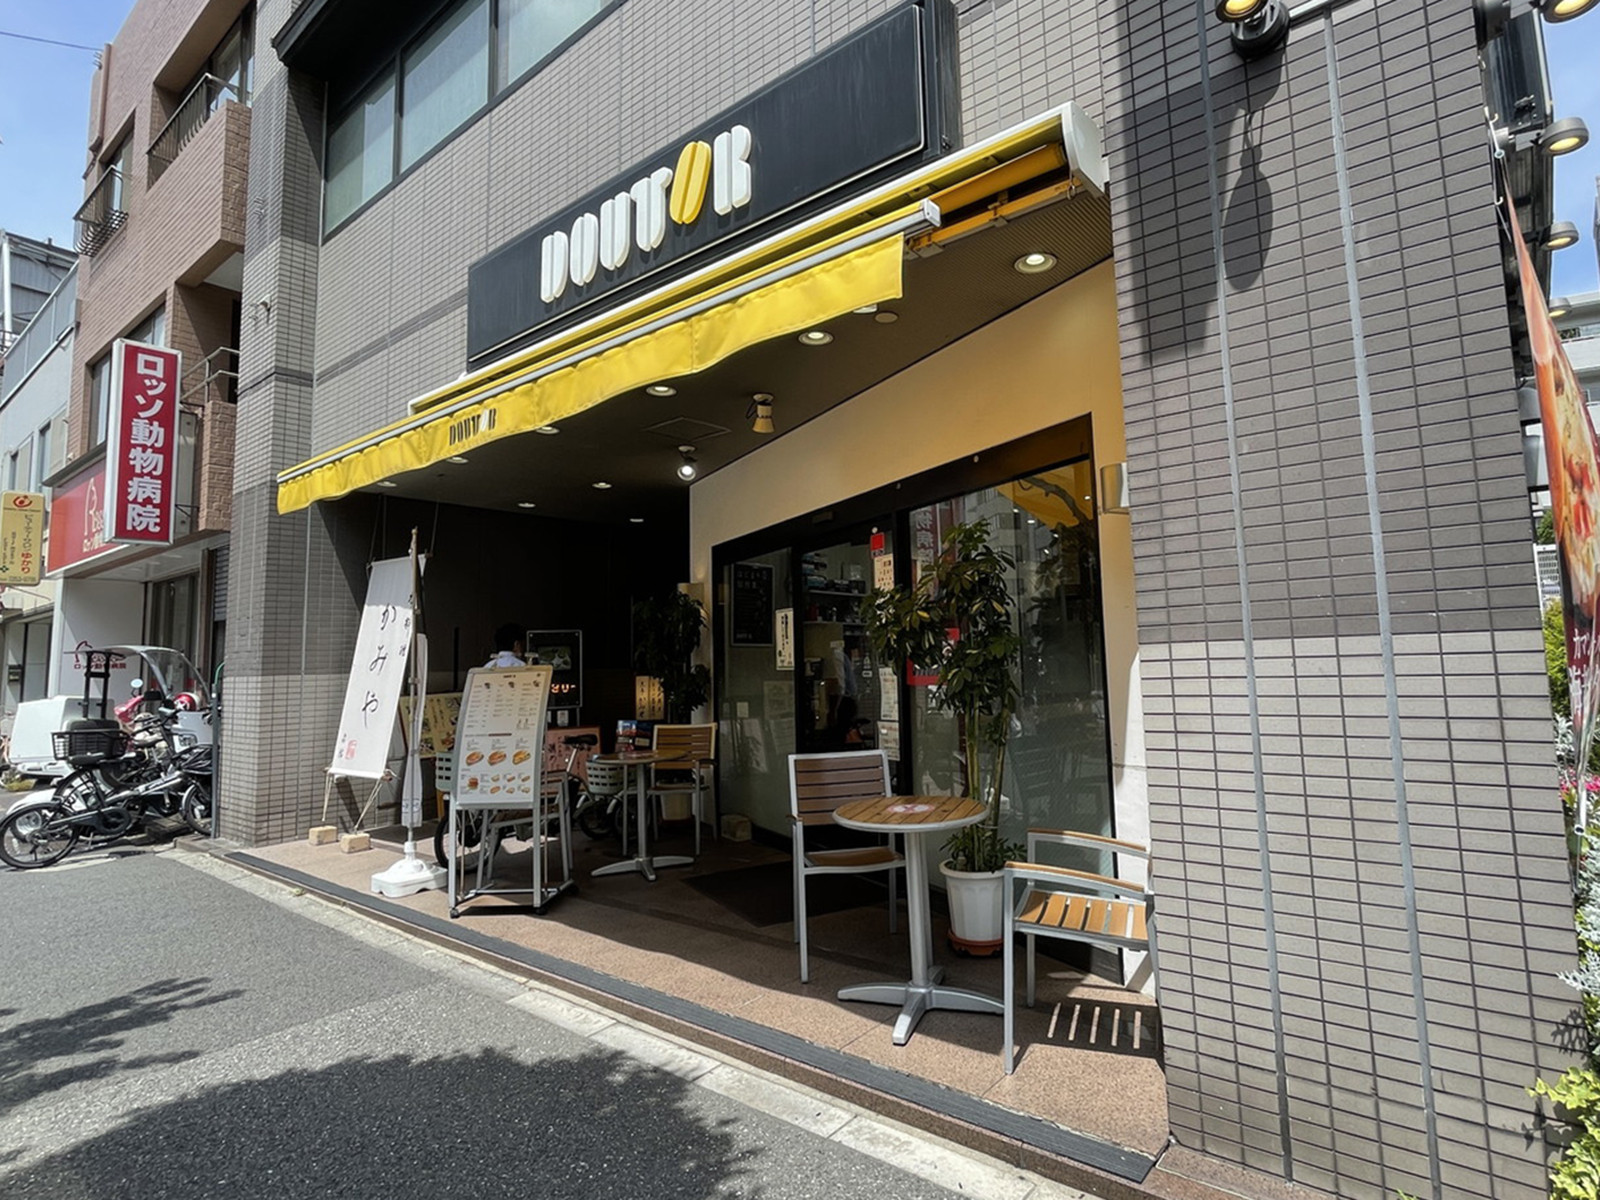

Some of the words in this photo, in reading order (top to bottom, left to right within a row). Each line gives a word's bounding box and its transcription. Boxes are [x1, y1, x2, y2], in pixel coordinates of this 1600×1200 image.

[541, 124, 752, 303] DOUTOR
[449, 408, 497, 446] DOUTOR
[361, 603, 397, 729] かみや
